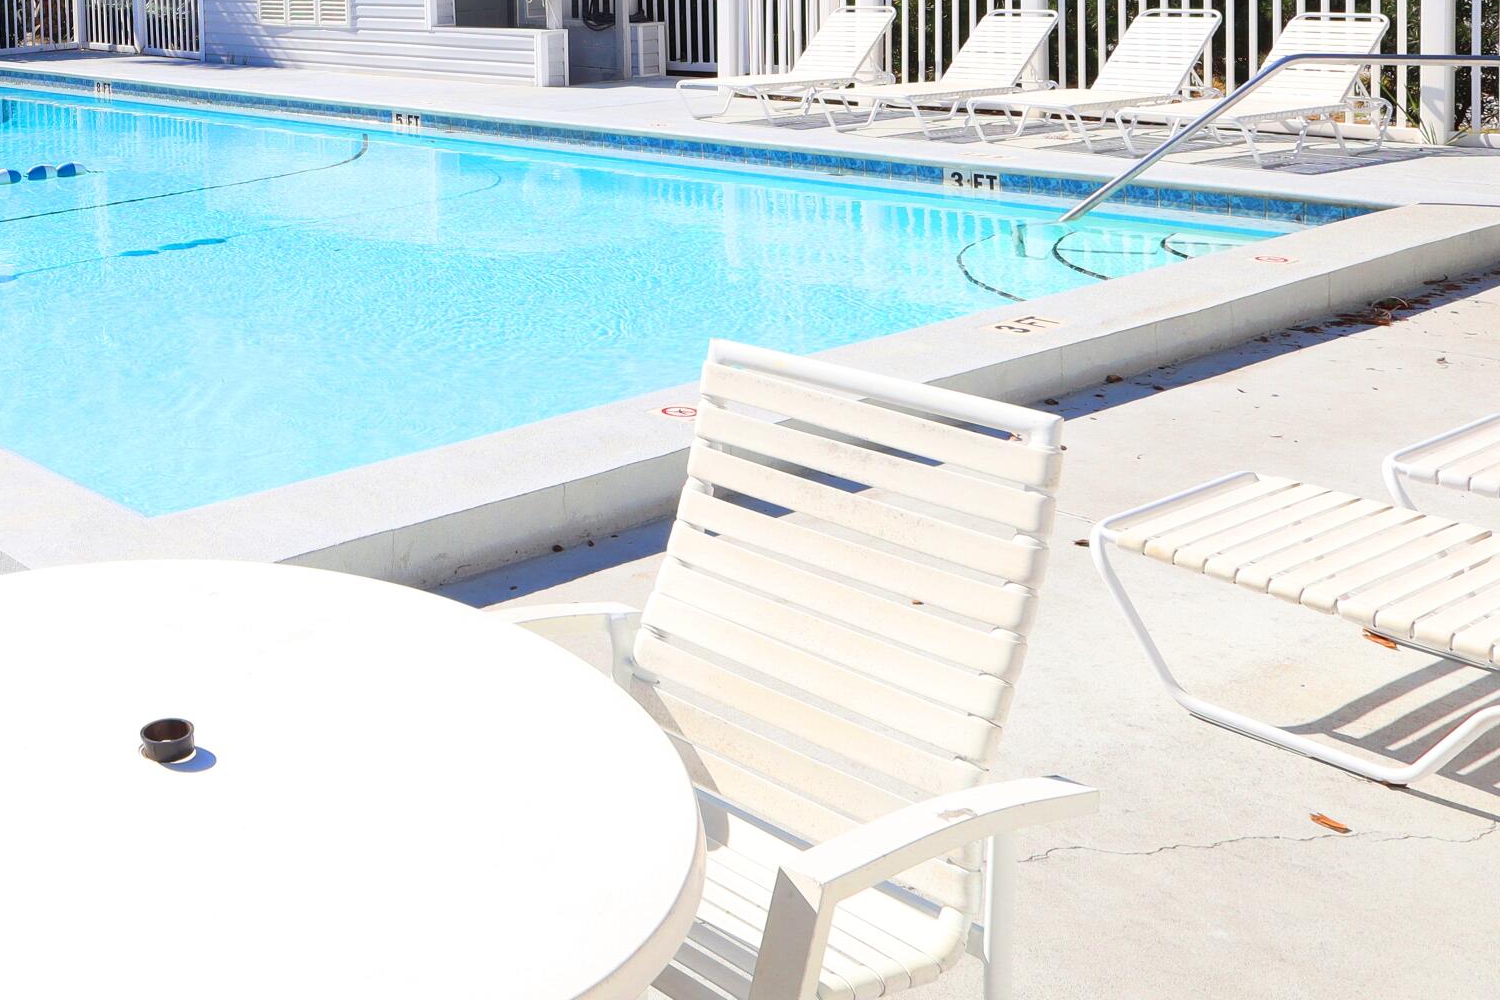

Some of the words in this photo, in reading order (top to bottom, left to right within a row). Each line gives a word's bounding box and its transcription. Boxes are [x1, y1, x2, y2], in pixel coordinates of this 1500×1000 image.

[96, 82, 101, 93] 8
[395, 113, 403, 125] 5
[407, 114, 420, 126] FT
[951, 171, 963, 187] 3
[973, 173, 997, 190] FT
[994, 325, 1031, 333] 3
[1013, 316, 1060, 328] FT
